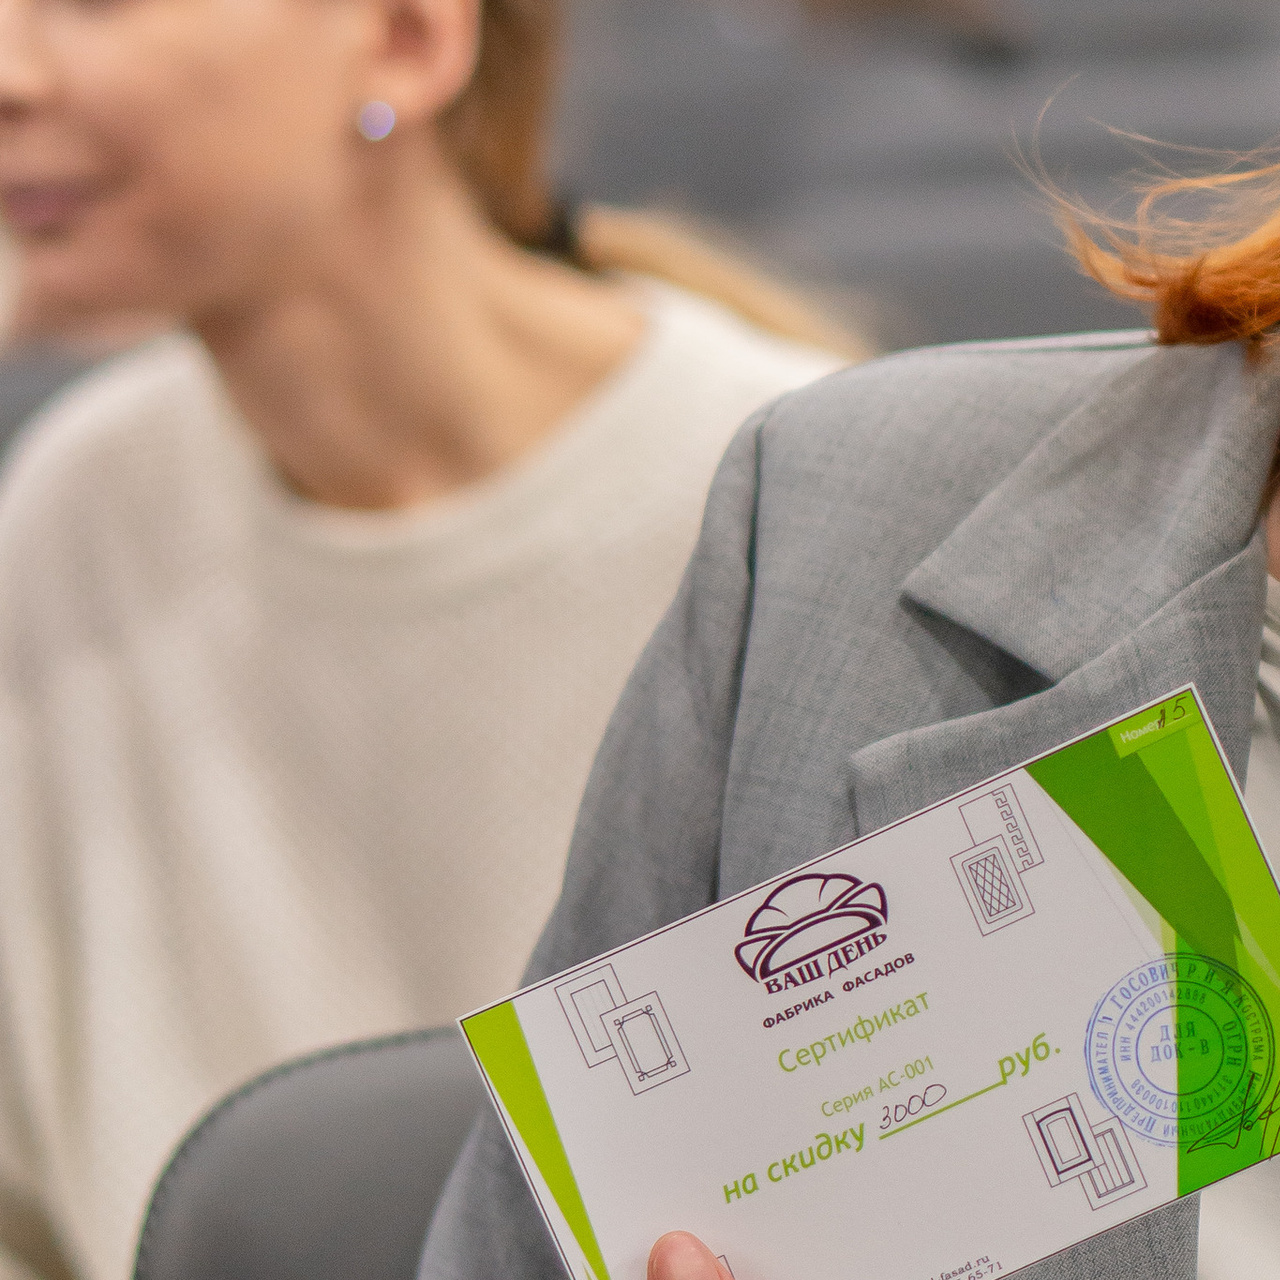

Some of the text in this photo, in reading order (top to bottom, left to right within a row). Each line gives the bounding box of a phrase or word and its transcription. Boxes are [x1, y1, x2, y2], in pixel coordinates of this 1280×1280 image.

[762, 953, 915, 1029] ФАБРИКА ФАСАДОВ
[763, 932, 888, 995] ВАШ ДЕНЬ
[777, 991, 929, 1073] Сертификат
[997, 1032, 1062, 1086] руб.
[821, 1055, 936, 1118] Серия АС-001
[878, 1083, 948, 1130] 3000
[722, 1122, 866, 1205] на скидку
